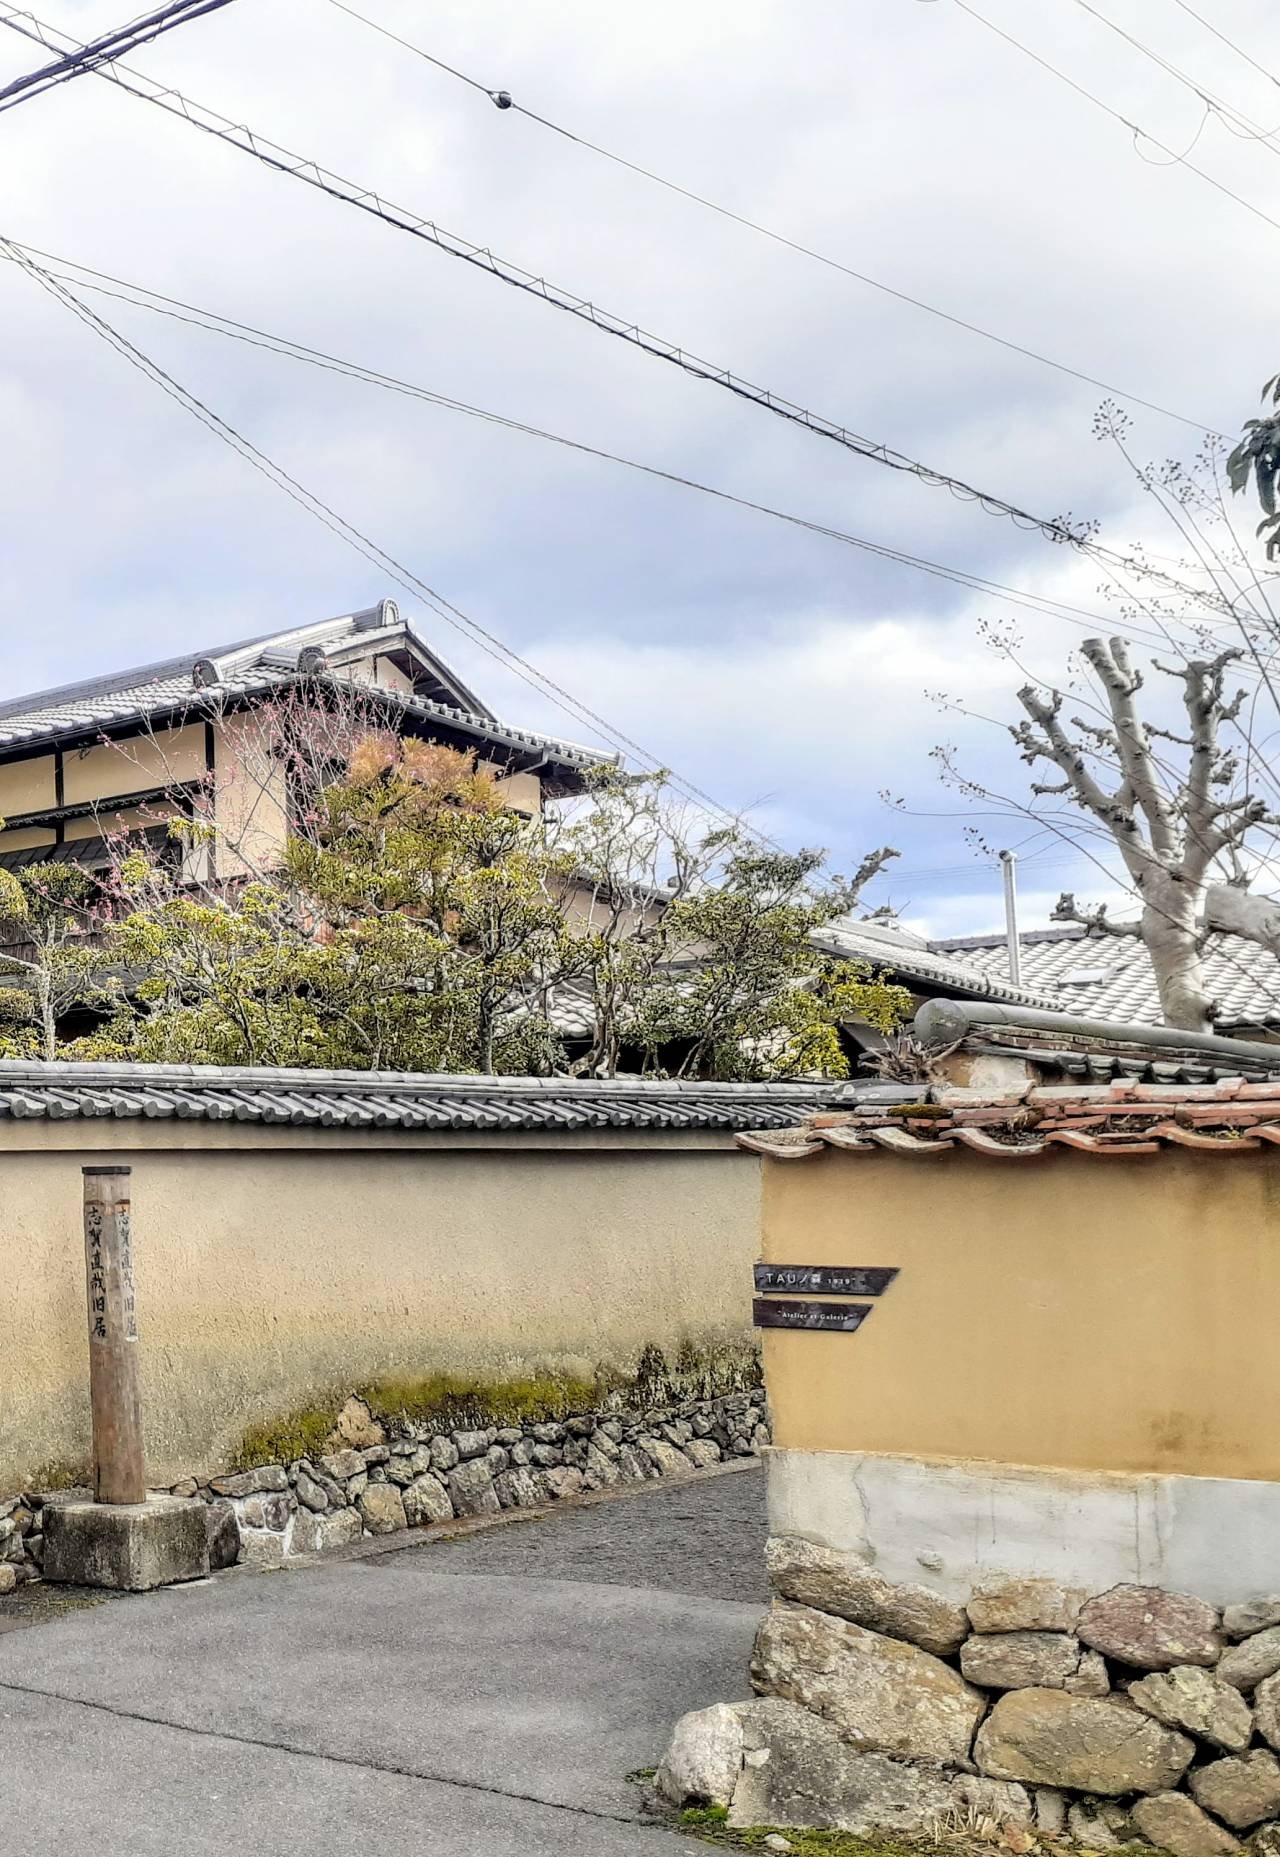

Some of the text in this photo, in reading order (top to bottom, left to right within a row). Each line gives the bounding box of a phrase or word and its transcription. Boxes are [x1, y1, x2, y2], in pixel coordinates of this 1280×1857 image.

[87, 1206, 107, 1338] 志賀直哉旧居
[118, 1207, 136, 1336] 志賀直哉旧居
